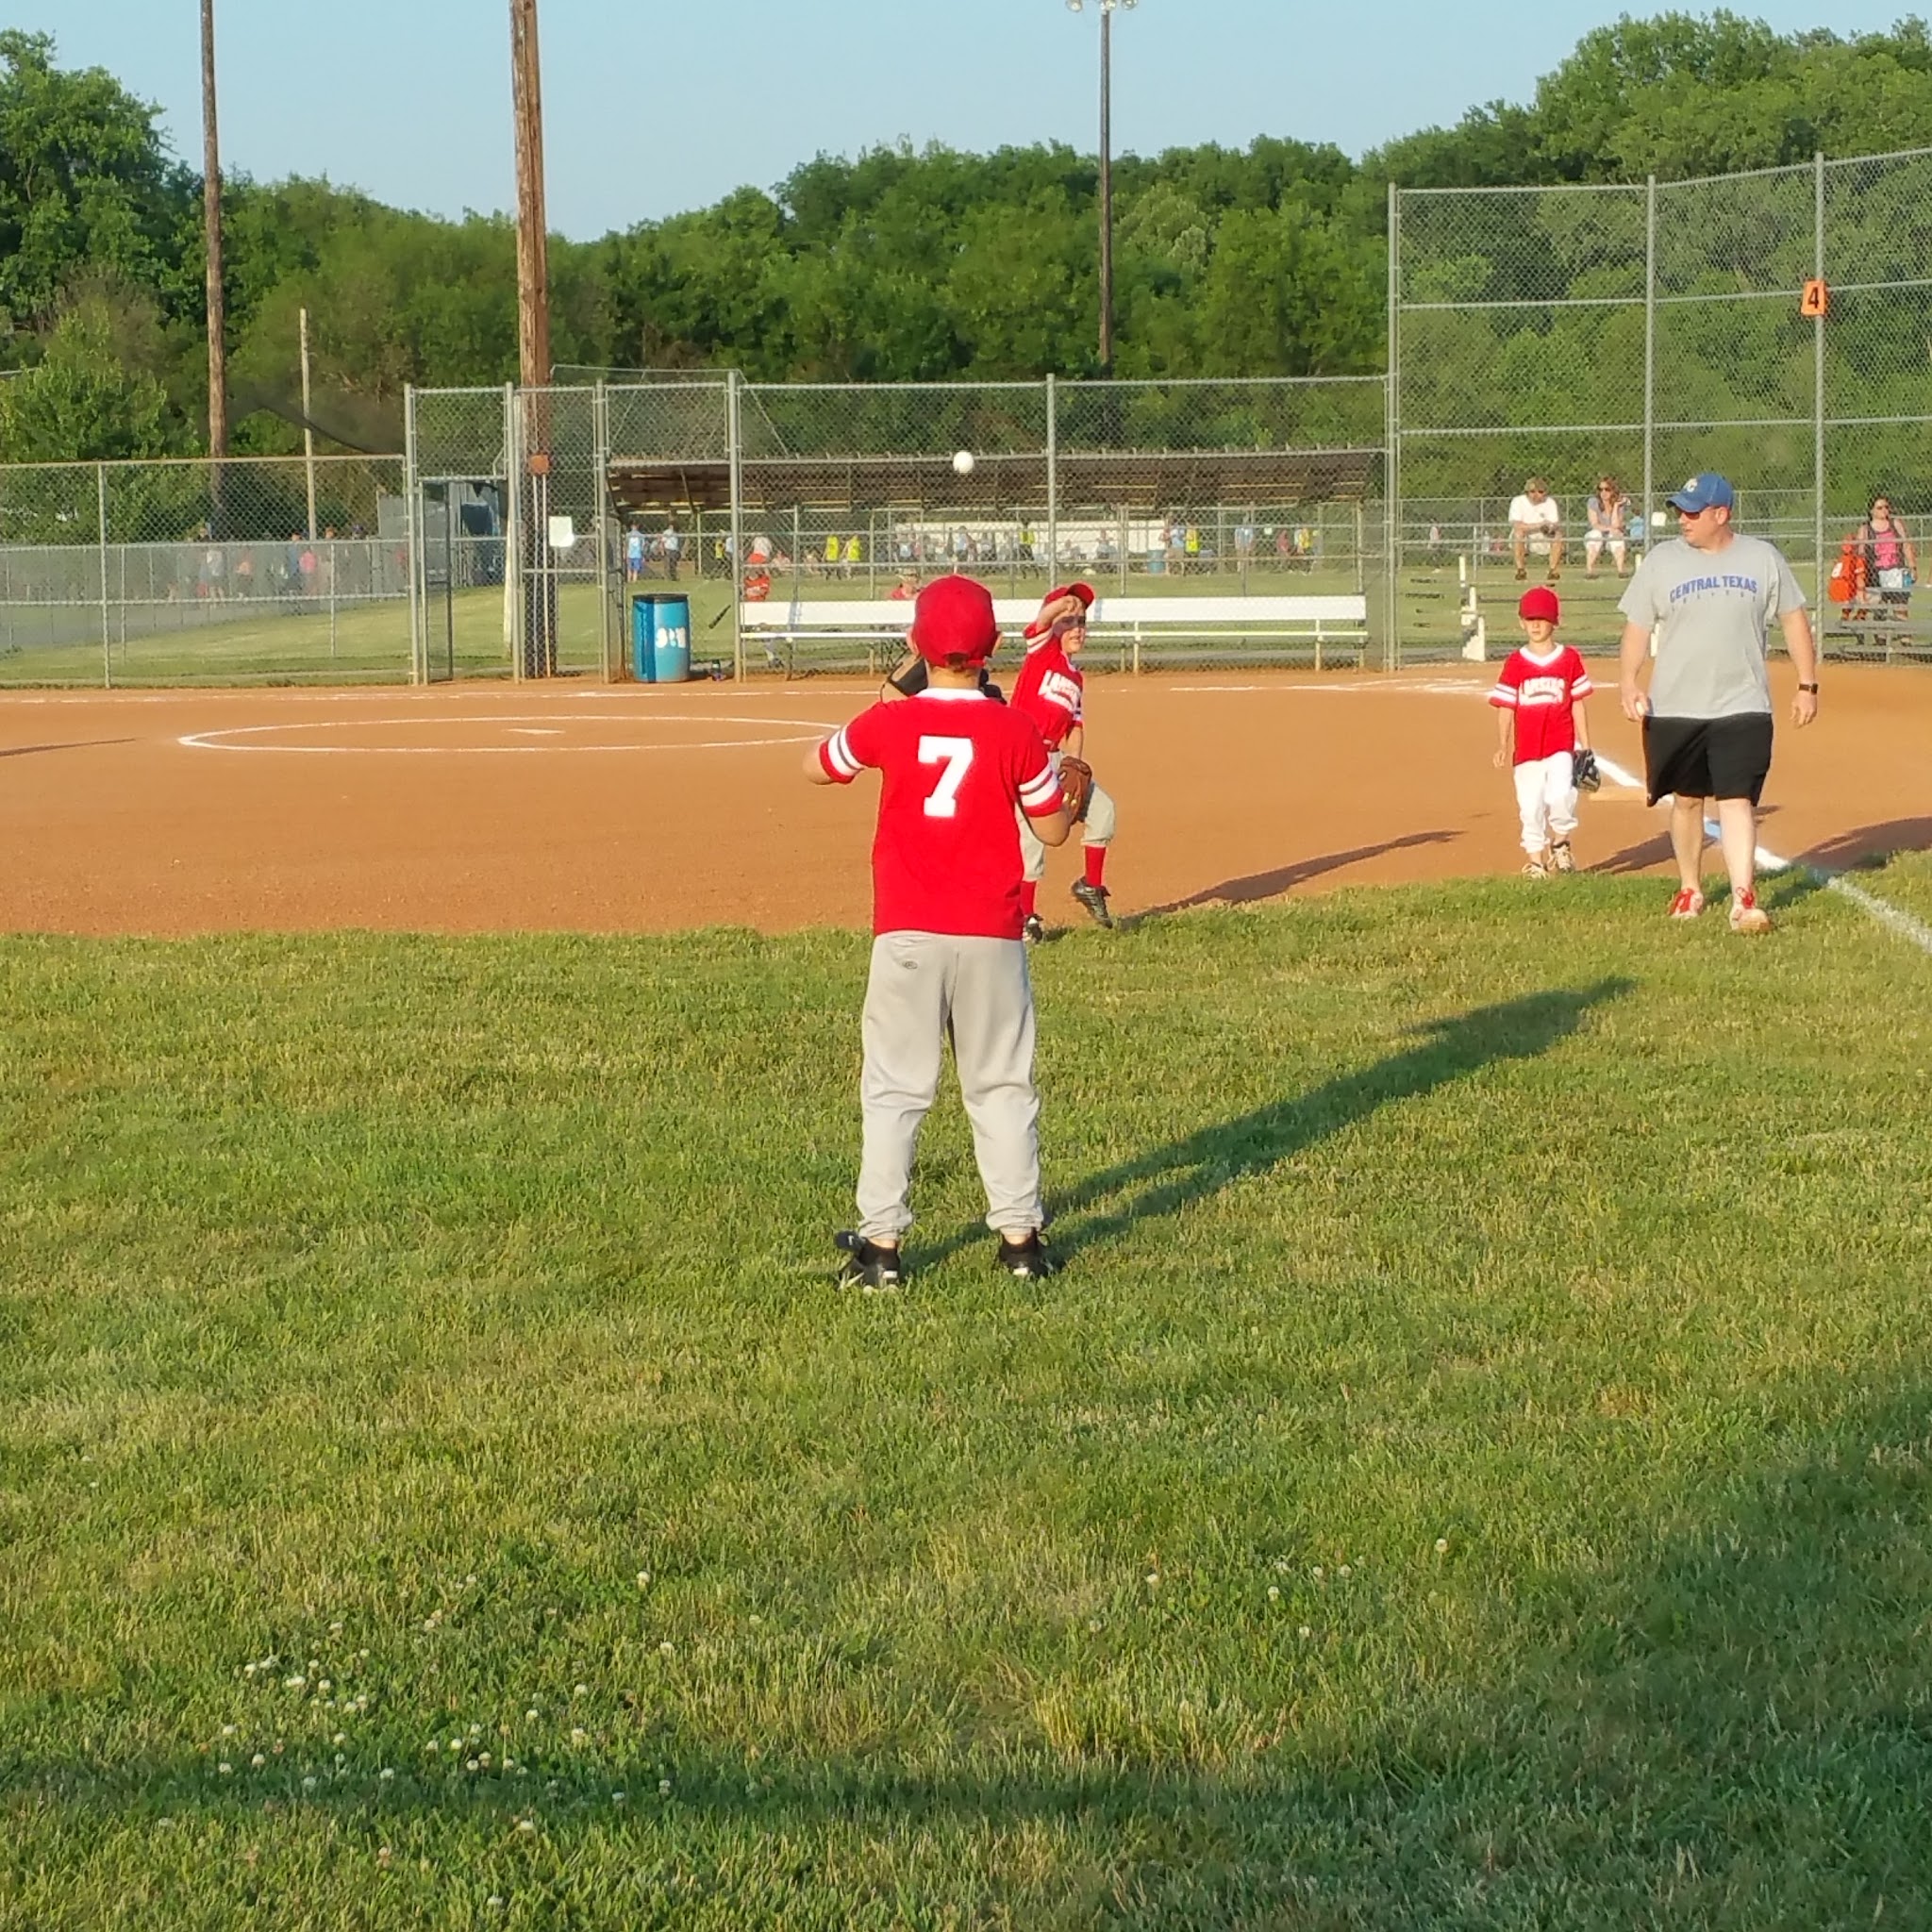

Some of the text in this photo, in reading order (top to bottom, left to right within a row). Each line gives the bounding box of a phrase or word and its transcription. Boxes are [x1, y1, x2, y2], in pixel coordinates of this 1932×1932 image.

[1807, 286, 1819, 308] 4
[1670, 576, 1721, 604] CENTRAL
[1722, 575, 1757, 594] TEXAS
[917, 734, 974, 818] 7
